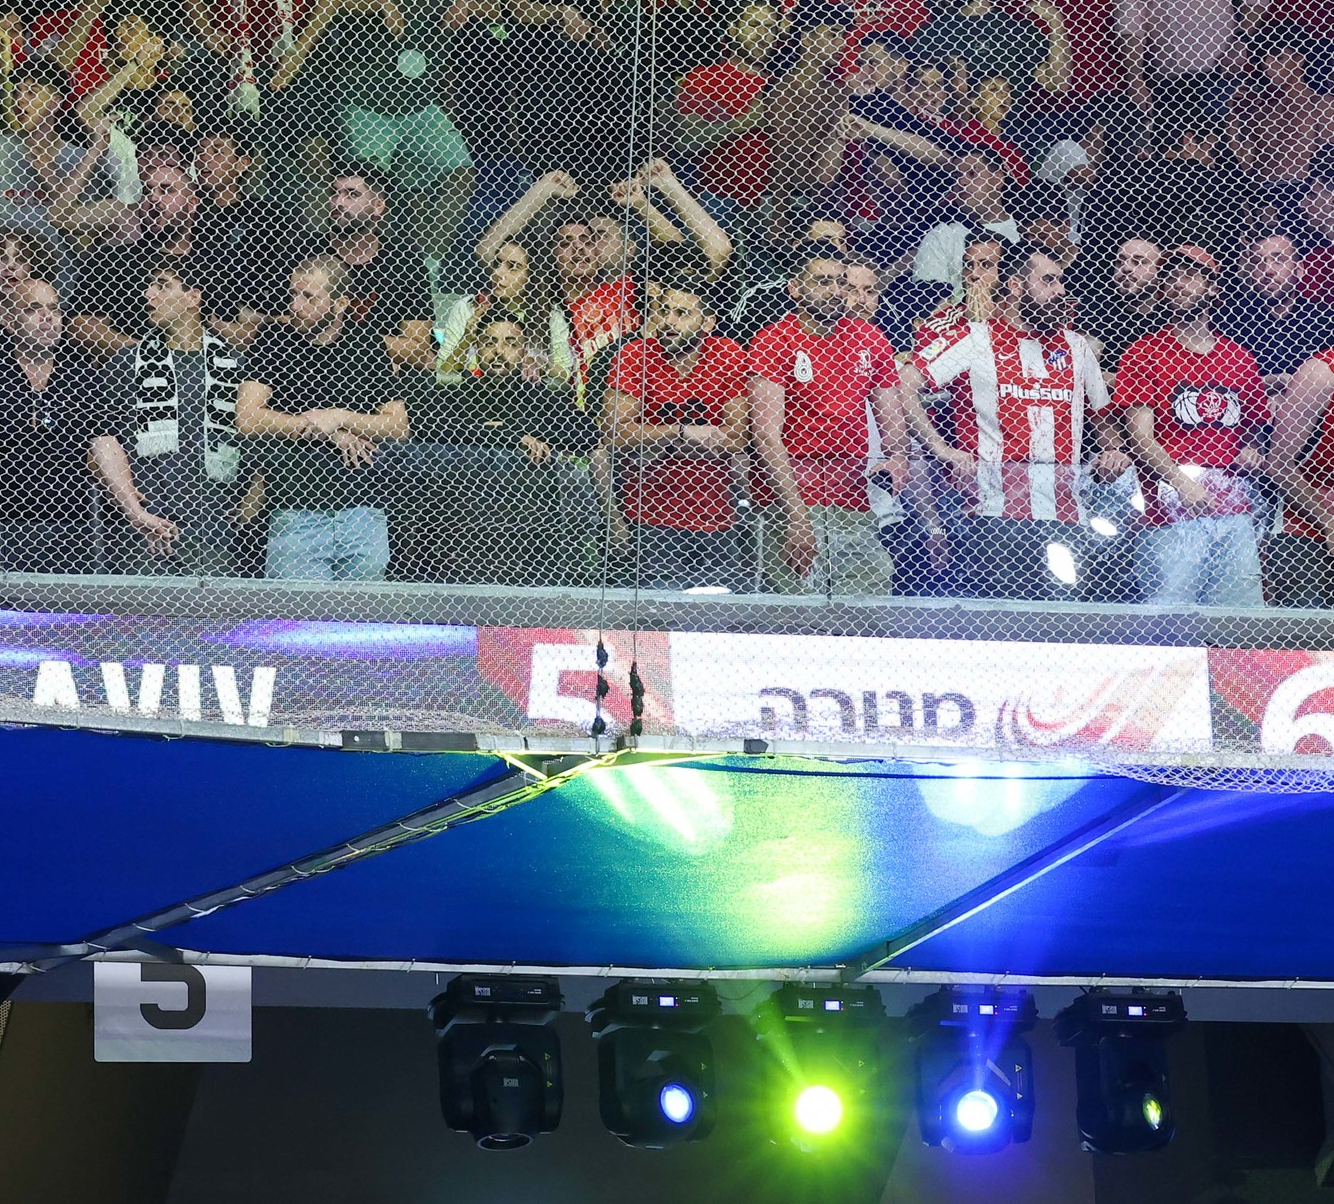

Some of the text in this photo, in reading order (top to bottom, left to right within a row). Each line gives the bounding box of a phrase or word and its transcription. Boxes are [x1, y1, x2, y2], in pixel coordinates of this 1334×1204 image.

[32, 659, 277, 728] AVIV
[527, 642, 607, 728] 5
[758, 683, 976, 737] מנורה
